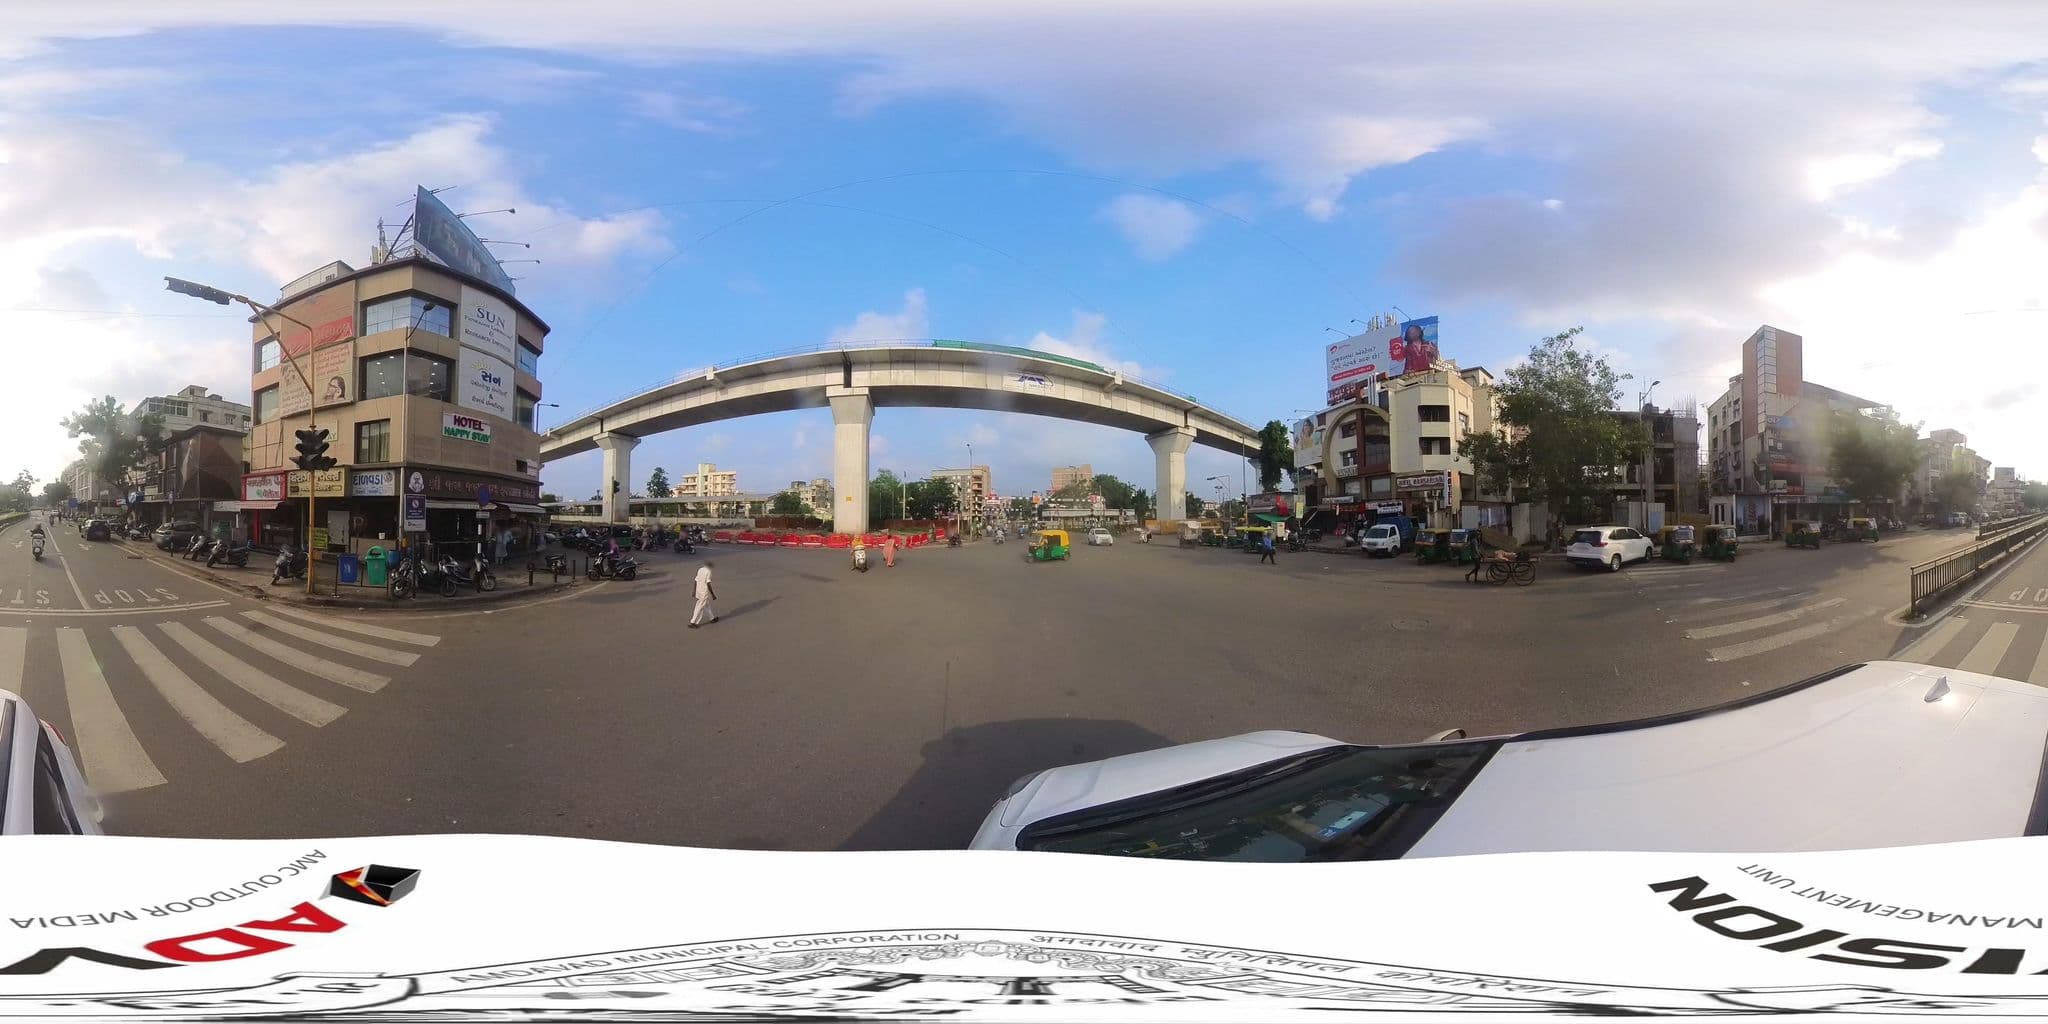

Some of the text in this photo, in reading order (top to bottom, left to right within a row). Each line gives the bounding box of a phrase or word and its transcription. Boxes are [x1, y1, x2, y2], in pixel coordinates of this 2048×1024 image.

[476, 307, 505, 330] SUN
[453, 415, 485, 432] HOTEL
[444, 427, 491, 443] HAPPY STAY
[94, 588, 180, 604] STOP
